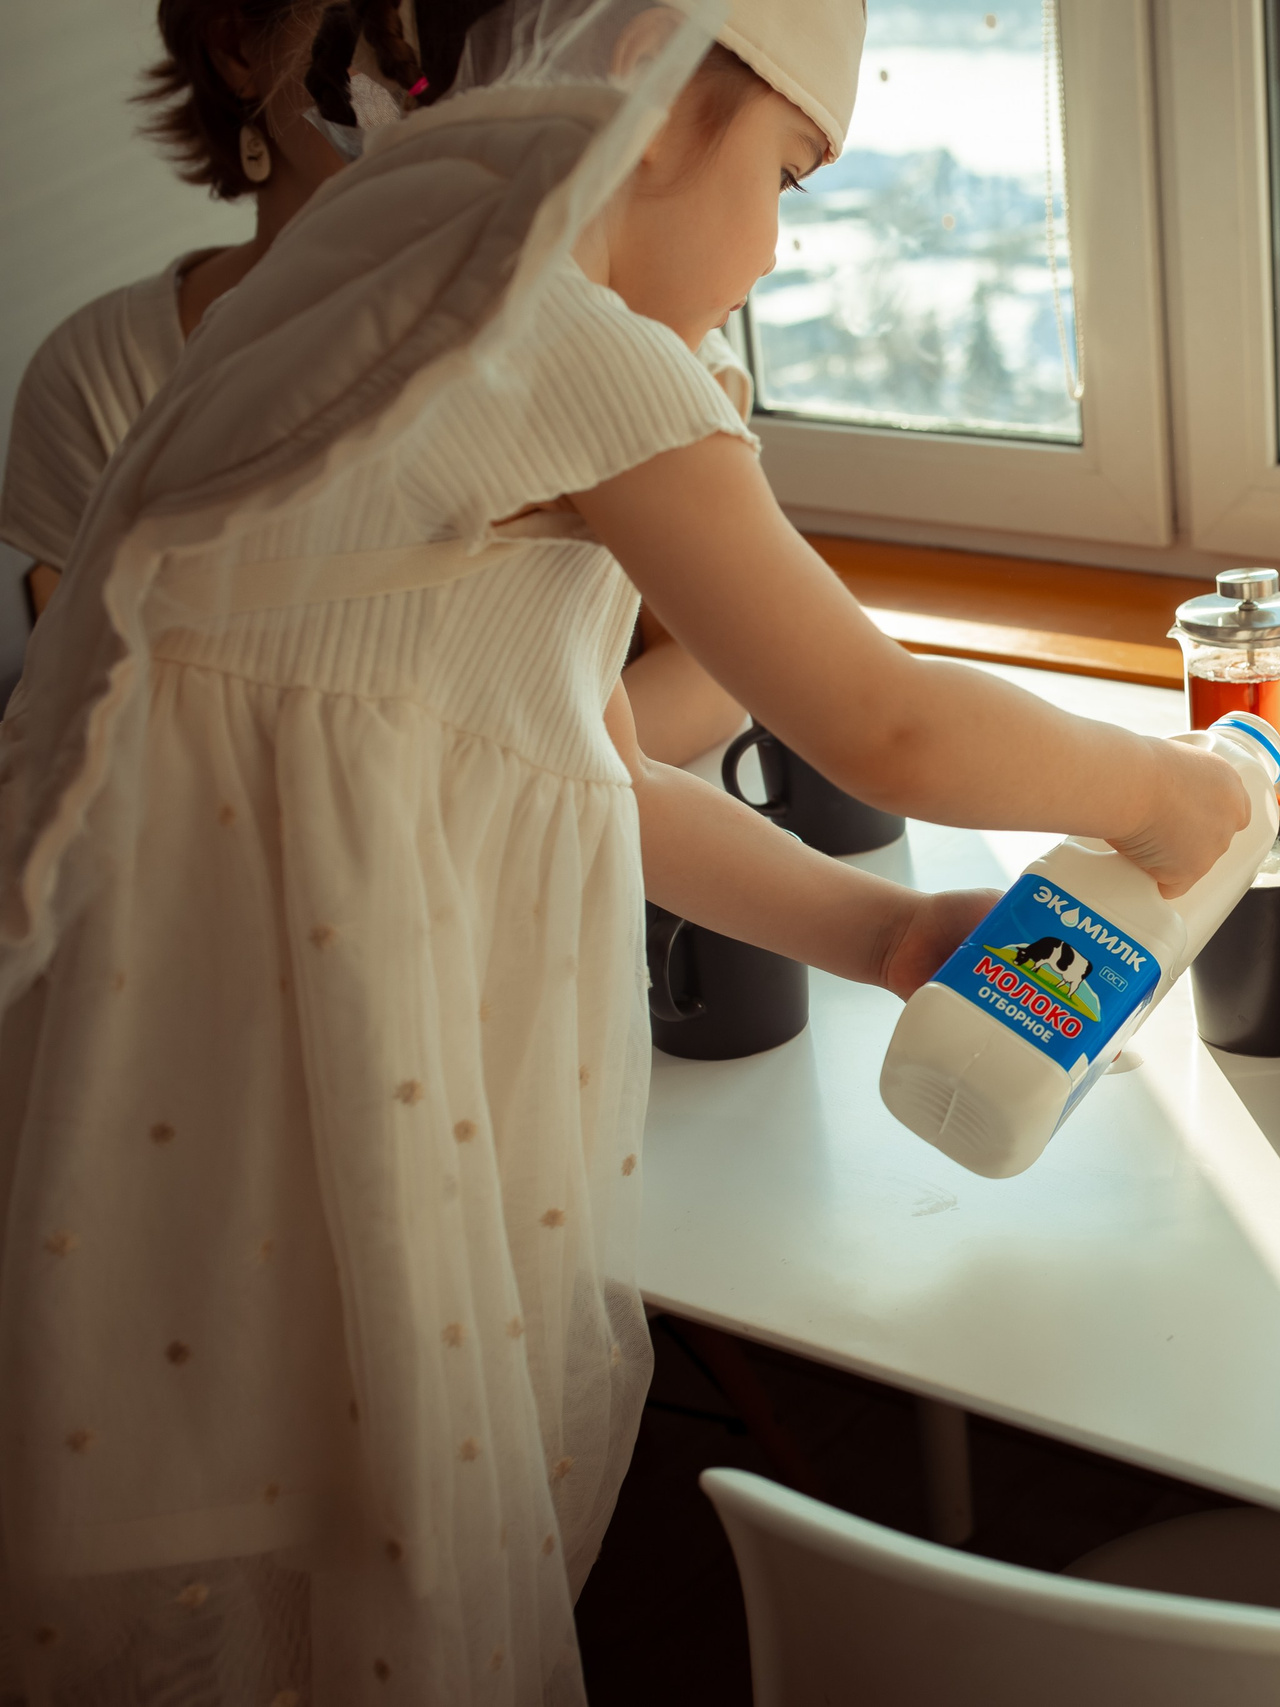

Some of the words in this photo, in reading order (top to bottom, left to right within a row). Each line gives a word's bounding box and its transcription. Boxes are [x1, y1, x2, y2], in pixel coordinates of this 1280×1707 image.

[1033, 886, 1147, 973] ЭКОМИЛК
[973, 956, 1083, 1039] МОЛОКО
[1102, 968, 1125, 988] ГОСТ
[978, 986, 1054, 1043] ОТБОРНОЕ
